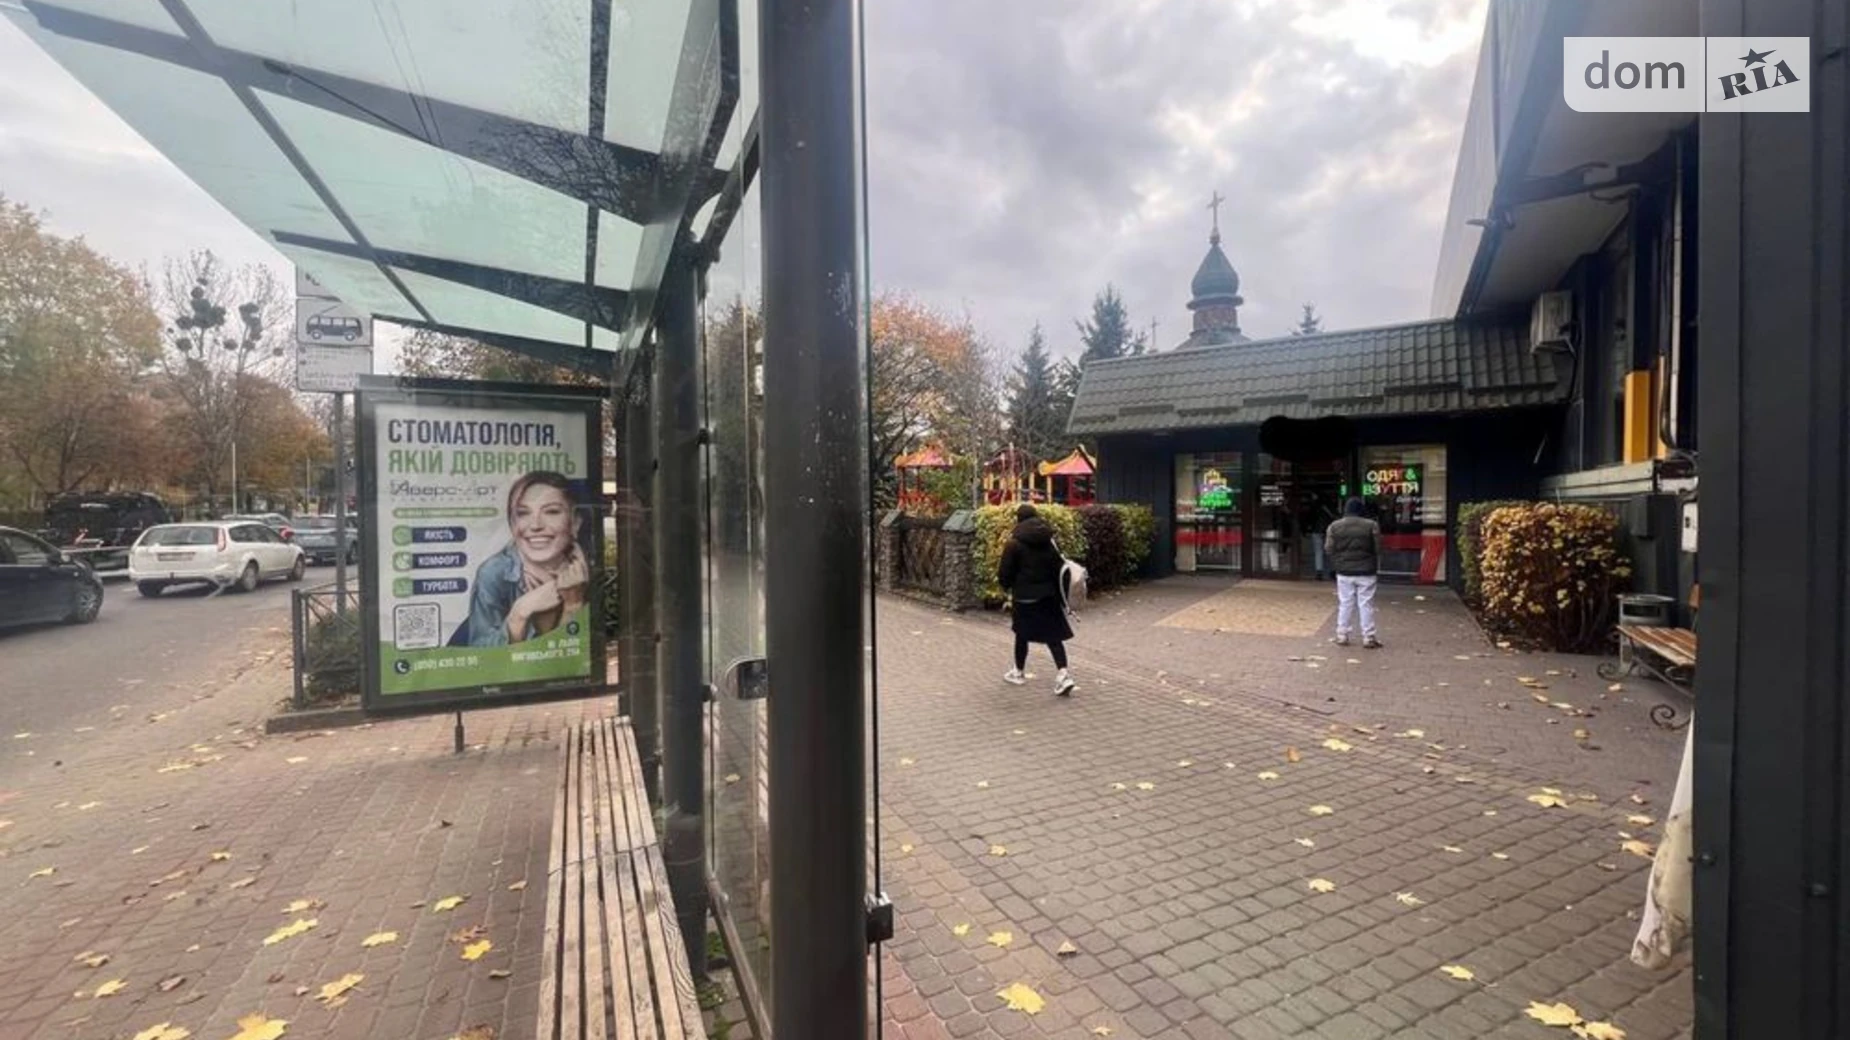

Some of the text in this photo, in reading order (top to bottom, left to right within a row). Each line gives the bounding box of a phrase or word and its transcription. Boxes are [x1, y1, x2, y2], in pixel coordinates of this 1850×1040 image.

[387, 418, 562, 449] СТОМАТОЛОГІЯ,
[387, 446, 577, 477] ЯКІЙ ДОВІРЯЮТЬ
[1405, 467, 1417, 481] &
[1362, 481, 1419, 496] ВЗУТТЯ
[424, 529, 454, 540] ЯКІСТЬ
[418, 555, 460, 566] КОМФОРТ
[421, 580, 459, 592] ТУРБОТА
